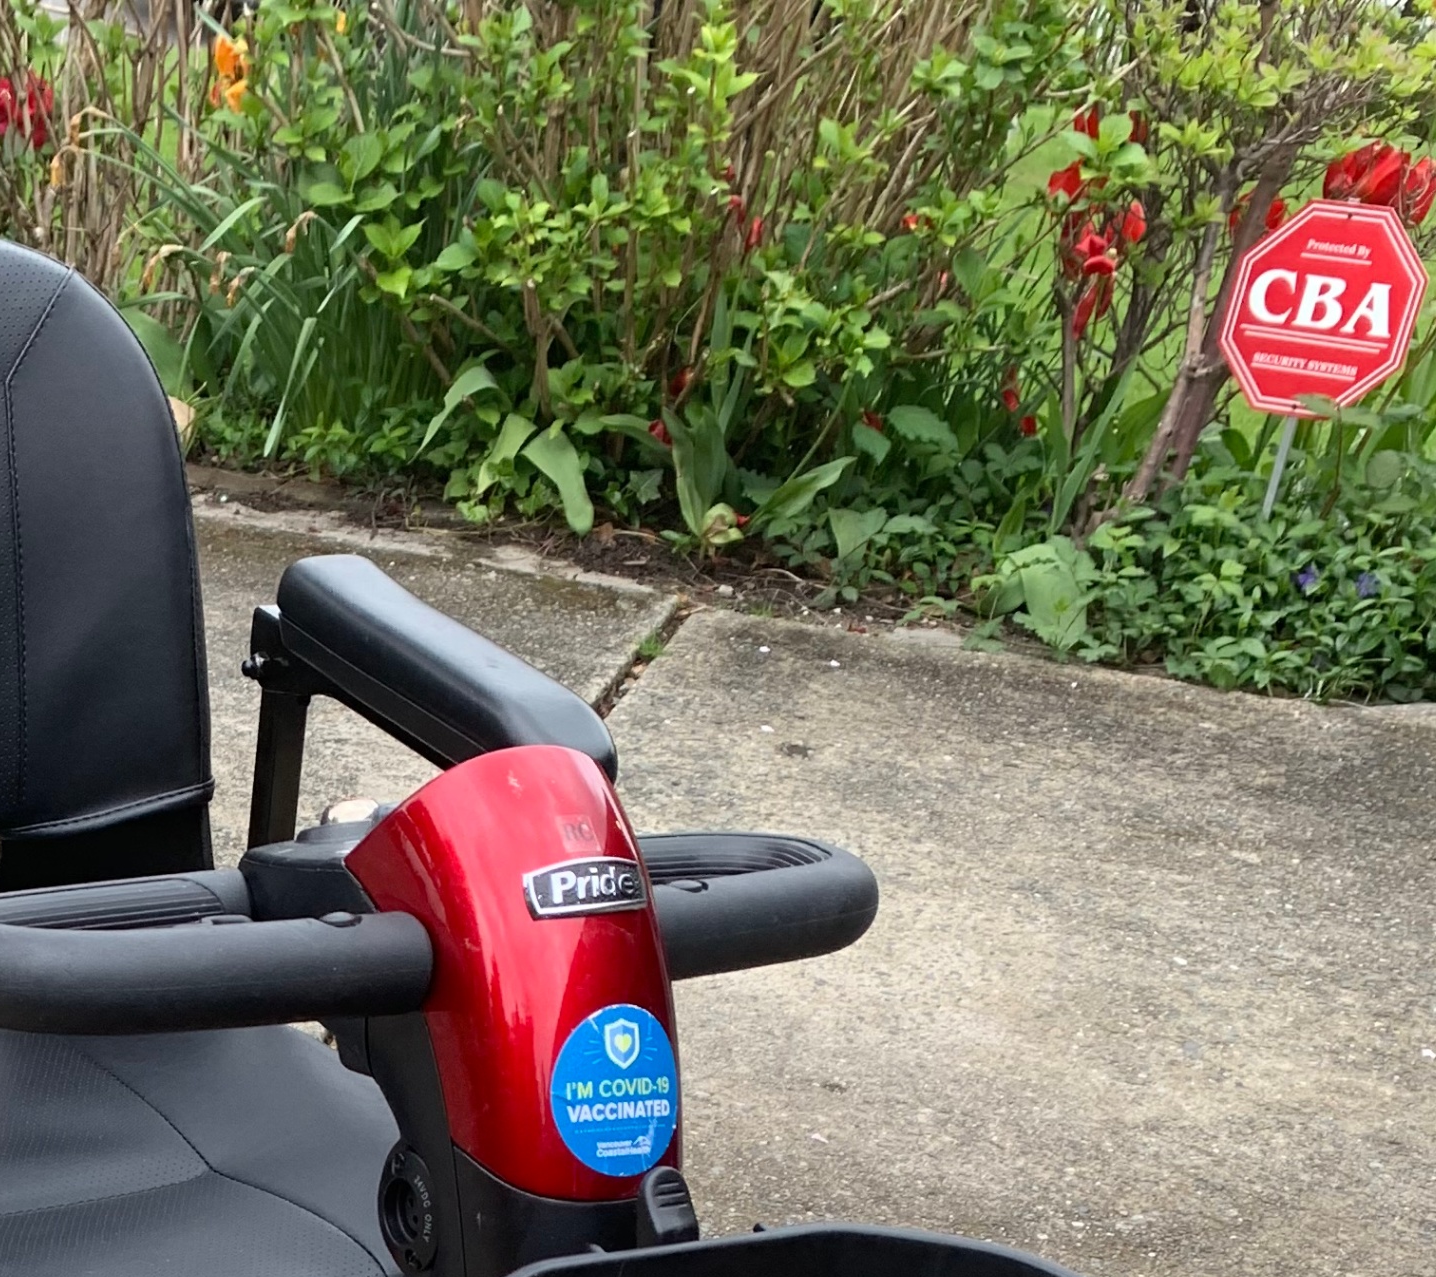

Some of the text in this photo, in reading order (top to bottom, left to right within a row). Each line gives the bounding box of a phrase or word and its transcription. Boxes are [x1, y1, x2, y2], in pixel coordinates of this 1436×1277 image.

[1249, 268, 1392, 338] CBA
[550, 866, 636, 904] Pride
[566, 1076, 669, 1100] I'M COVID-19
[566, 1099, 670, 1123] VACCINATED
